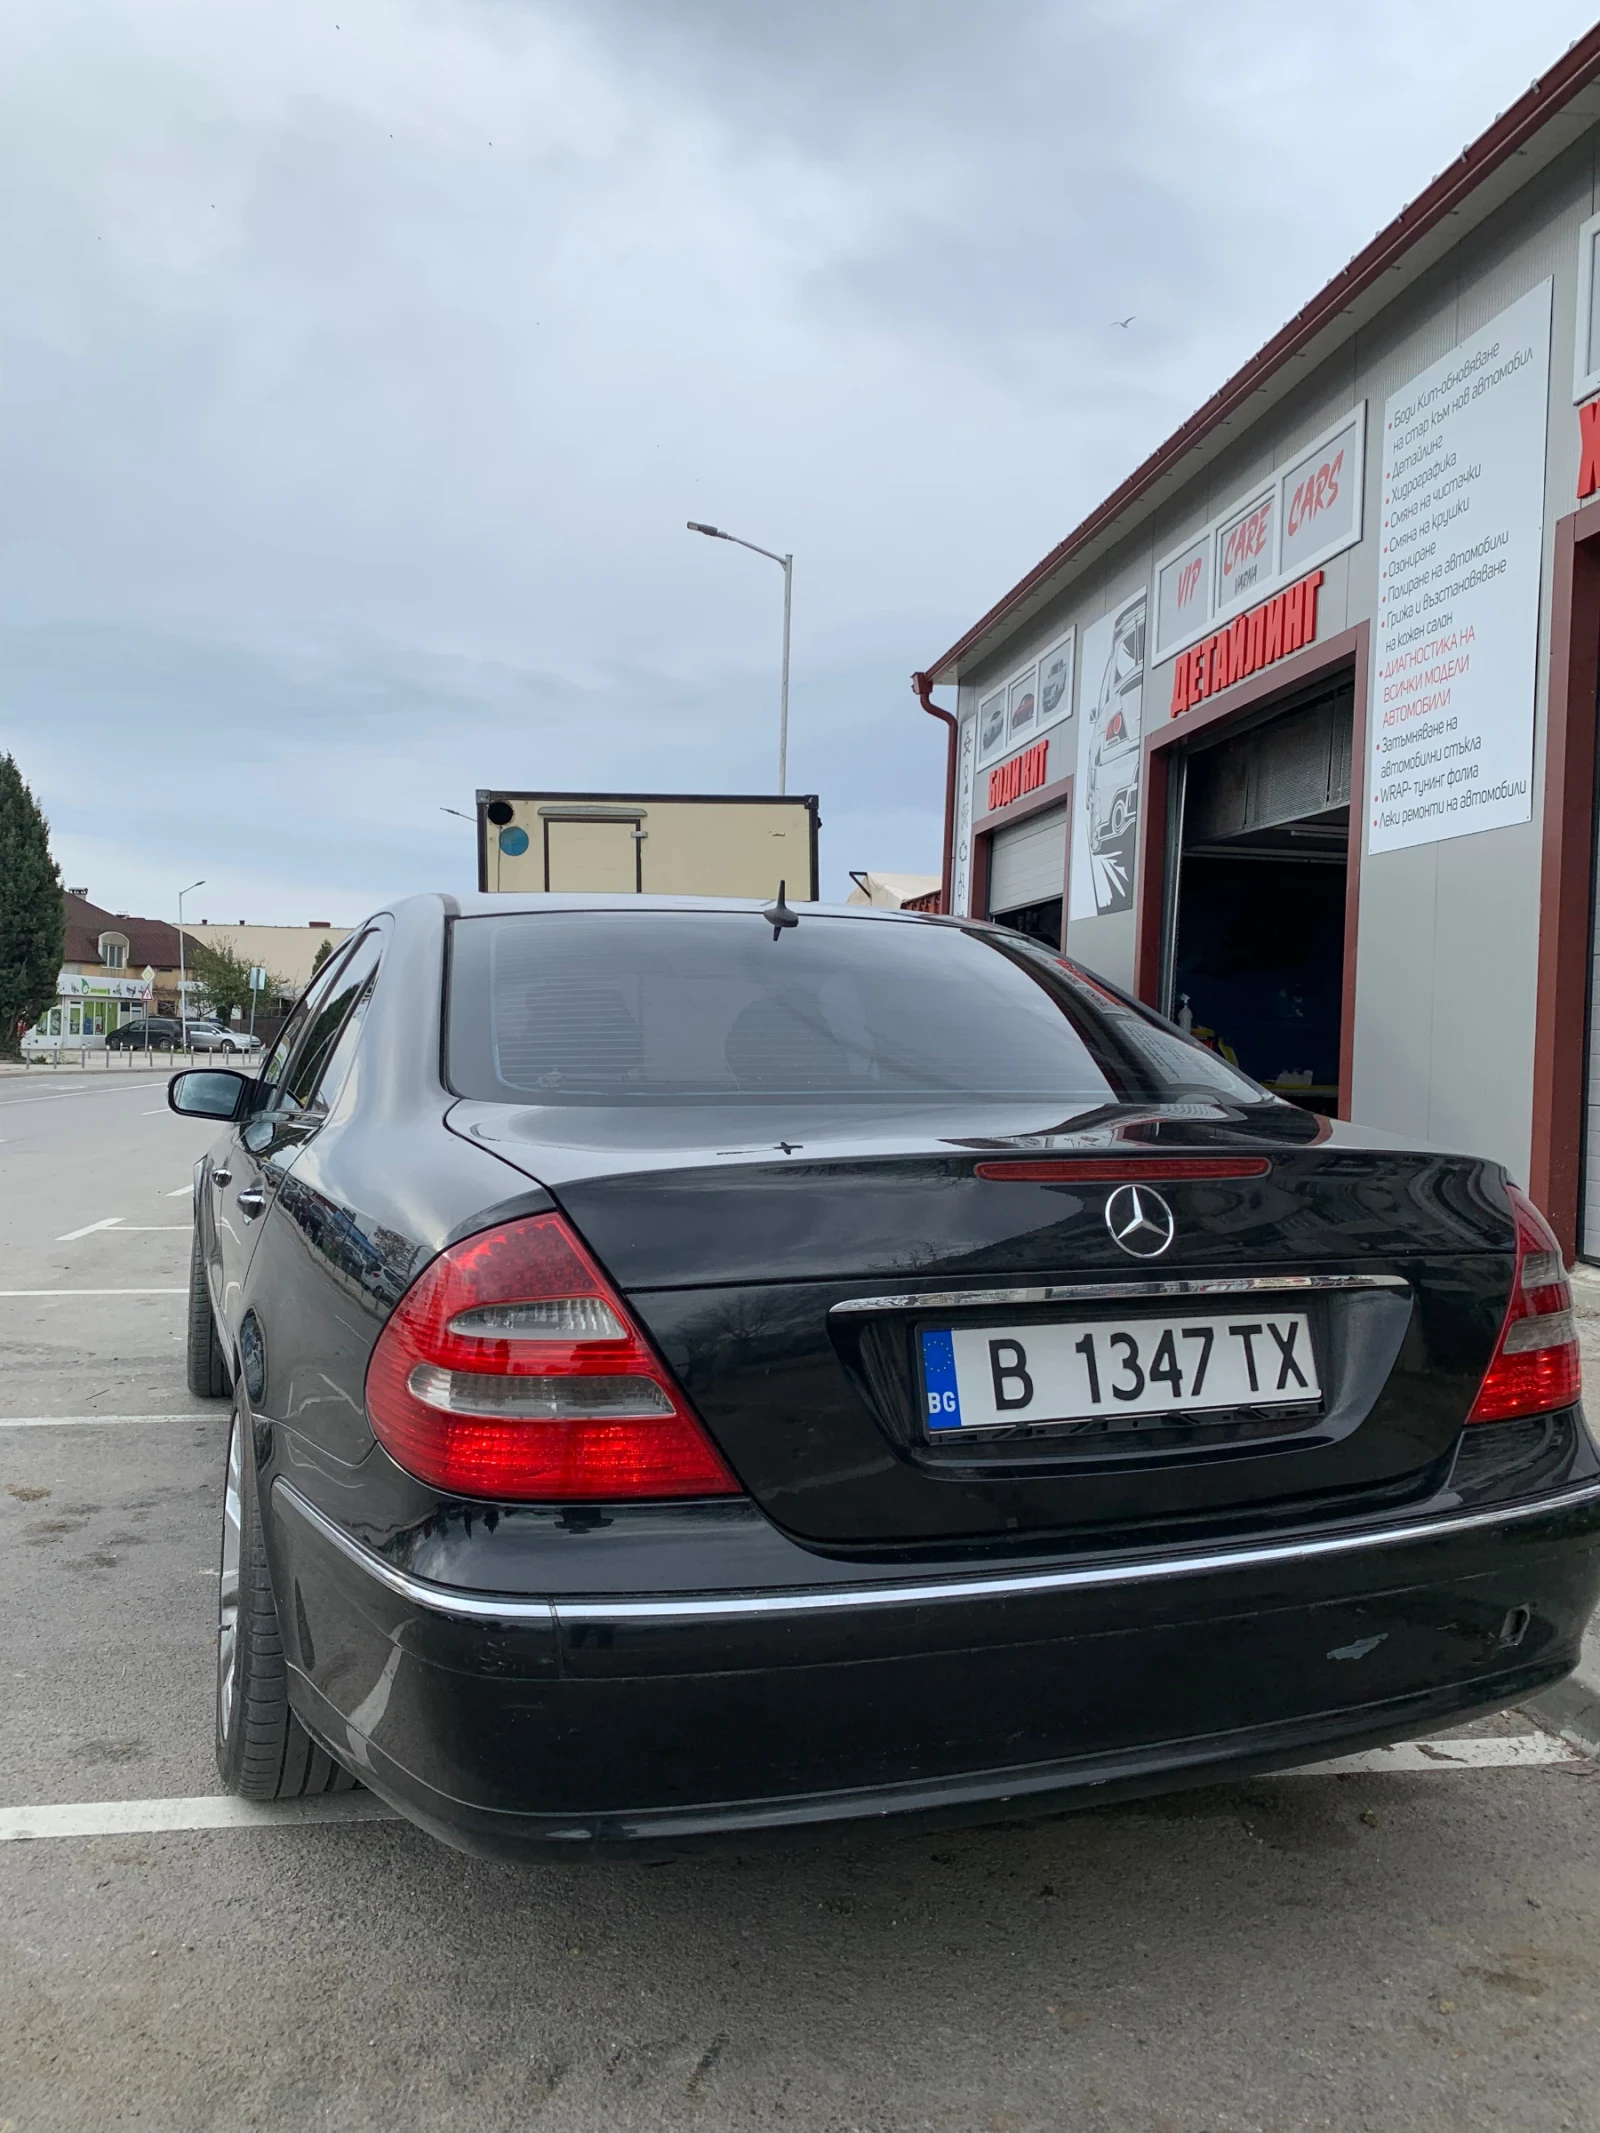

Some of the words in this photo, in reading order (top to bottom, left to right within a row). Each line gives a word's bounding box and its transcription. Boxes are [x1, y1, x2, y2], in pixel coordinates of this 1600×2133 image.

[1393, 436, 1404, 453] на
[1404, 419, 1429, 447] стар
[1431, 406, 1450, 429] към
[1451, 390, 1470, 414] нов
[1472, 347, 1534, 400] автомобил
[1393, 402, 1417, 429] Боди
[1391, 435, 1443, 481] Детайлинг
[1391, 451, 1457, 505] Хидрографика
[1288, 448, 1344, 537] CARS
[1390, 500, 1418, 528] Смяна
[1420, 493, 1431, 510] на
[1433, 462, 1482, 502] чистачки
[1224, 503, 1271, 577] CARE
[1389, 527, 1418, 553] Смяна
[1418, 518, 1430, 536] на
[1432, 496, 1470, 531] крушки
[1177, 556, 1202, 612] VIP
[1387, 571, 1429, 603] Полиране
[1431, 565, 1443, 581] на
[1444, 530, 1509, 574] автомобили
[1388, 542, 1436, 578] Озониране
[1387, 604, 1414, 630] Грижа
[1415, 601, 1421, 614] и
[1422, 559, 1507, 611] възстановяване
[1170, 570, 1324, 718] ДЕТАЙЛИНГ
[1384, 632, 1457, 681] ДИАГНОСТИКА
[1460, 625, 1476, 647] НА
[1385, 638, 1396, 653] на
[1397, 624, 1425, 648] кожен
[1426, 612, 1453, 635] салон
[1383, 674, 1423, 703] ВСИЧКИ
[1424, 654, 1470, 687] МОДЕЛИ
[1381, 722, 1444, 754] Затъмняване
[1446, 716, 1458, 733] на
[1382, 688, 1451, 728] АВТОМОБИЛИ
[988, 755, 1022, 811] БОДИ
[1021, 739, 1049, 794] КИТ
[1380, 749, 1442, 779] автомобилни
[1443, 735, 1482, 760] стъкла
[1413, 773, 1445, 797] тунинг
[1446, 764, 1479, 789] фолиа
[1379, 811, 1400, 829] Леки
[1401, 800, 1445, 827] ремонти
[1446, 796, 1458, 811] на
[1460, 779, 1527, 809] автомобили
[988, 1339, 1034, 1411] B
[1075, 1326, 1214, 1403] 1347
[1229, 1321, 1309, 1392] TX
[927, 1391, 956, 1415] BG
